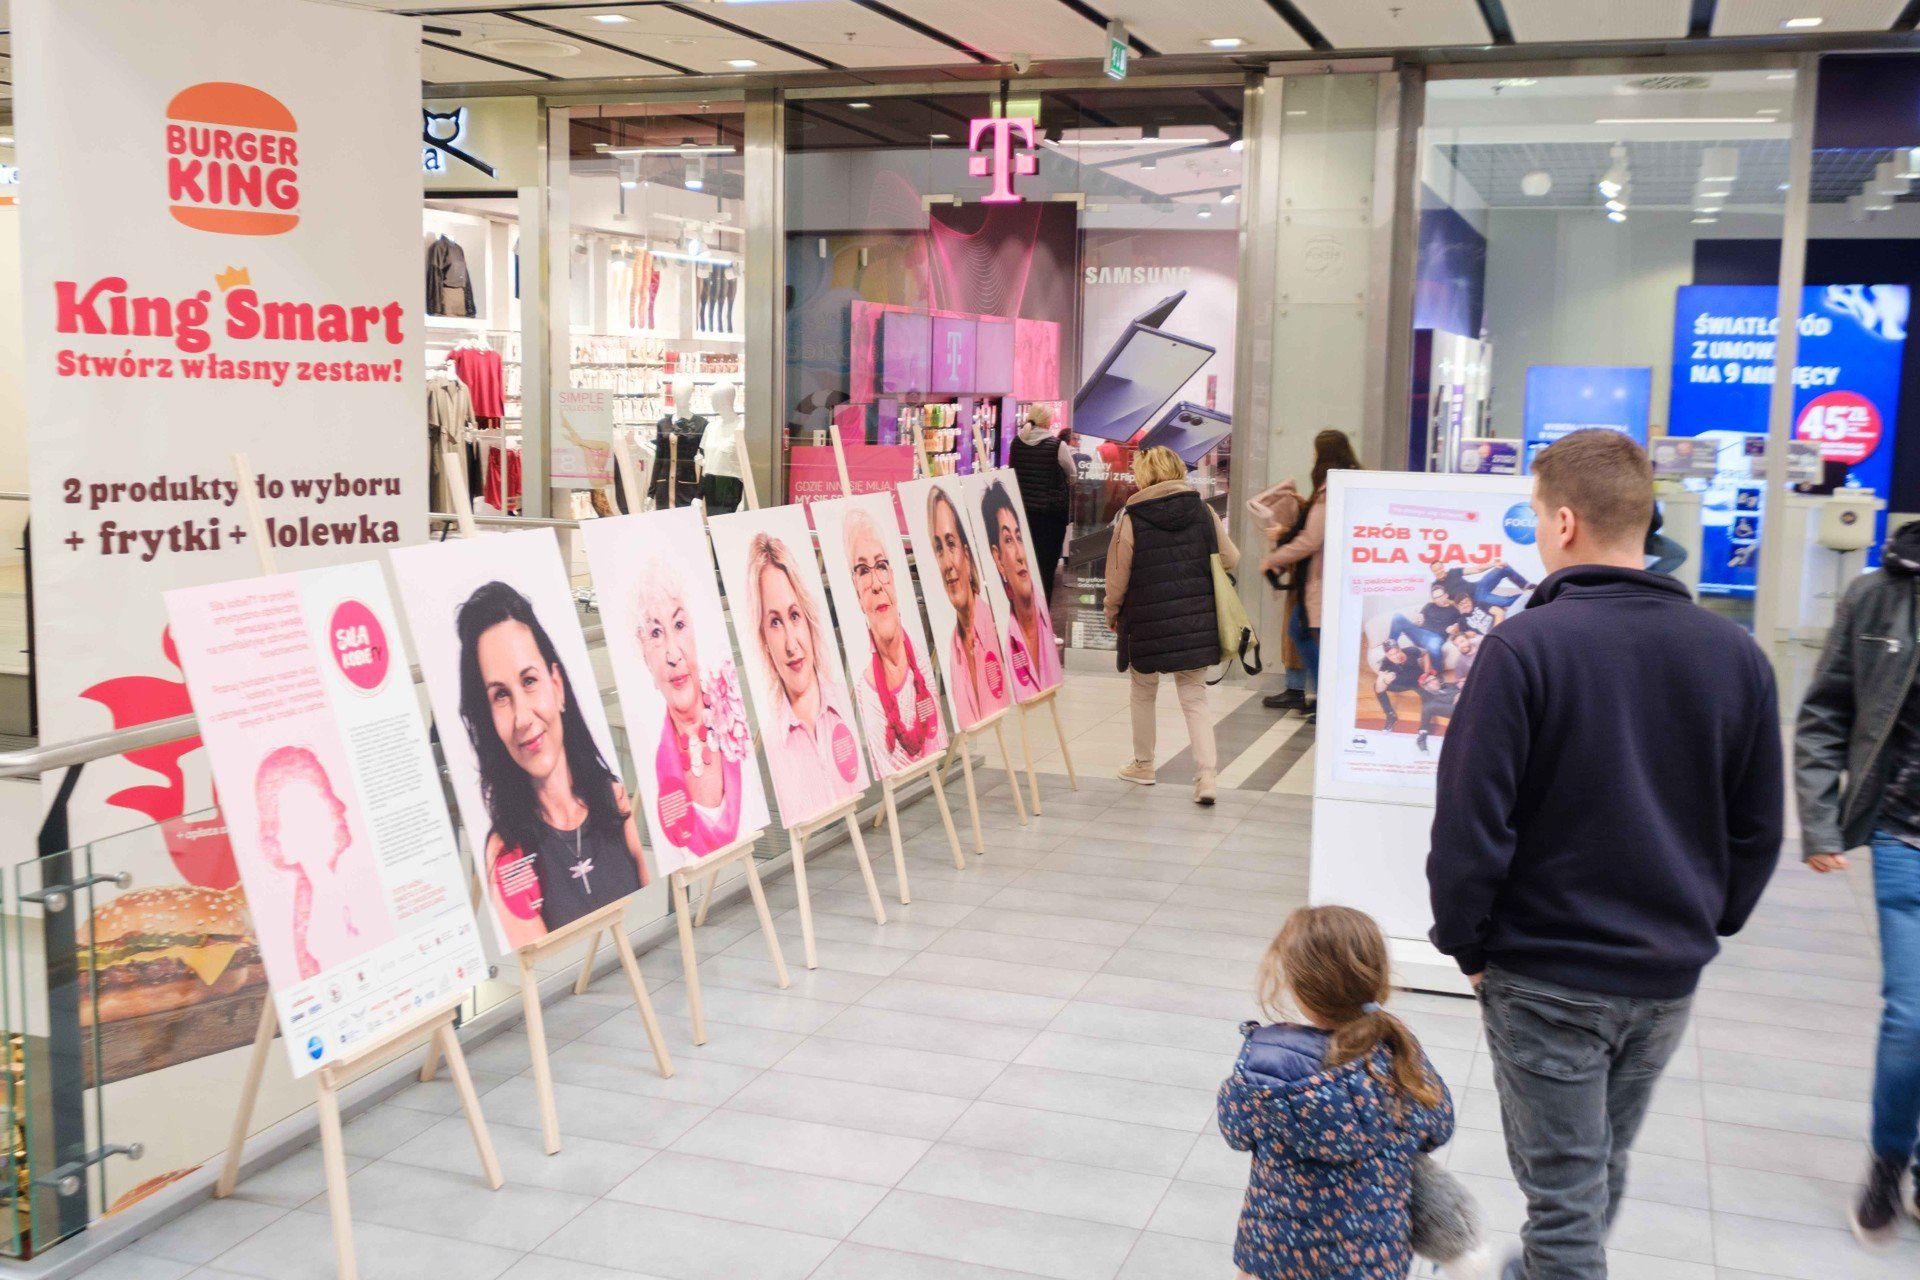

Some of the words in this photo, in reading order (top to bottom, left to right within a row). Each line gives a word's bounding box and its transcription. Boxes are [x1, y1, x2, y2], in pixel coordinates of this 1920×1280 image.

[166, 124, 299, 167] BURGER
[168, 157, 300, 210] KING
[1085, 266, 1191, 284] SAMSUNG
[55, 276, 212, 353] King
[225, 288, 404, 344] Smart
[1691, 340, 1708, 359] Z
[1709, 341, 1776, 360] UMOW
[56, 349, 173, 378] Stwórz
[180, 353, 290, 387] własny
[297, 359, 403, 382] zestaw!
[1690, 364, 1722, 383] NA
[1723, 362, 1741, 383] 9
[559, 392, 604, 404] SIMPLE
[1799, 405, 1846, 440] 45
[63, 478, 82, 503] 2
[89, 474, 239, 511] produkty
[290, 472, 402, 504] wyboru
[795, 480, 823, 492] GDZIE
[98, 517, 221, 562] frytki
[1353, 522, 1411, 540] ZRÓB
[1419, 528, 1449, 541] TO
[1352, 547, 1409, 563] DLA
[1417, 543, 1502, 564] JAJ!
